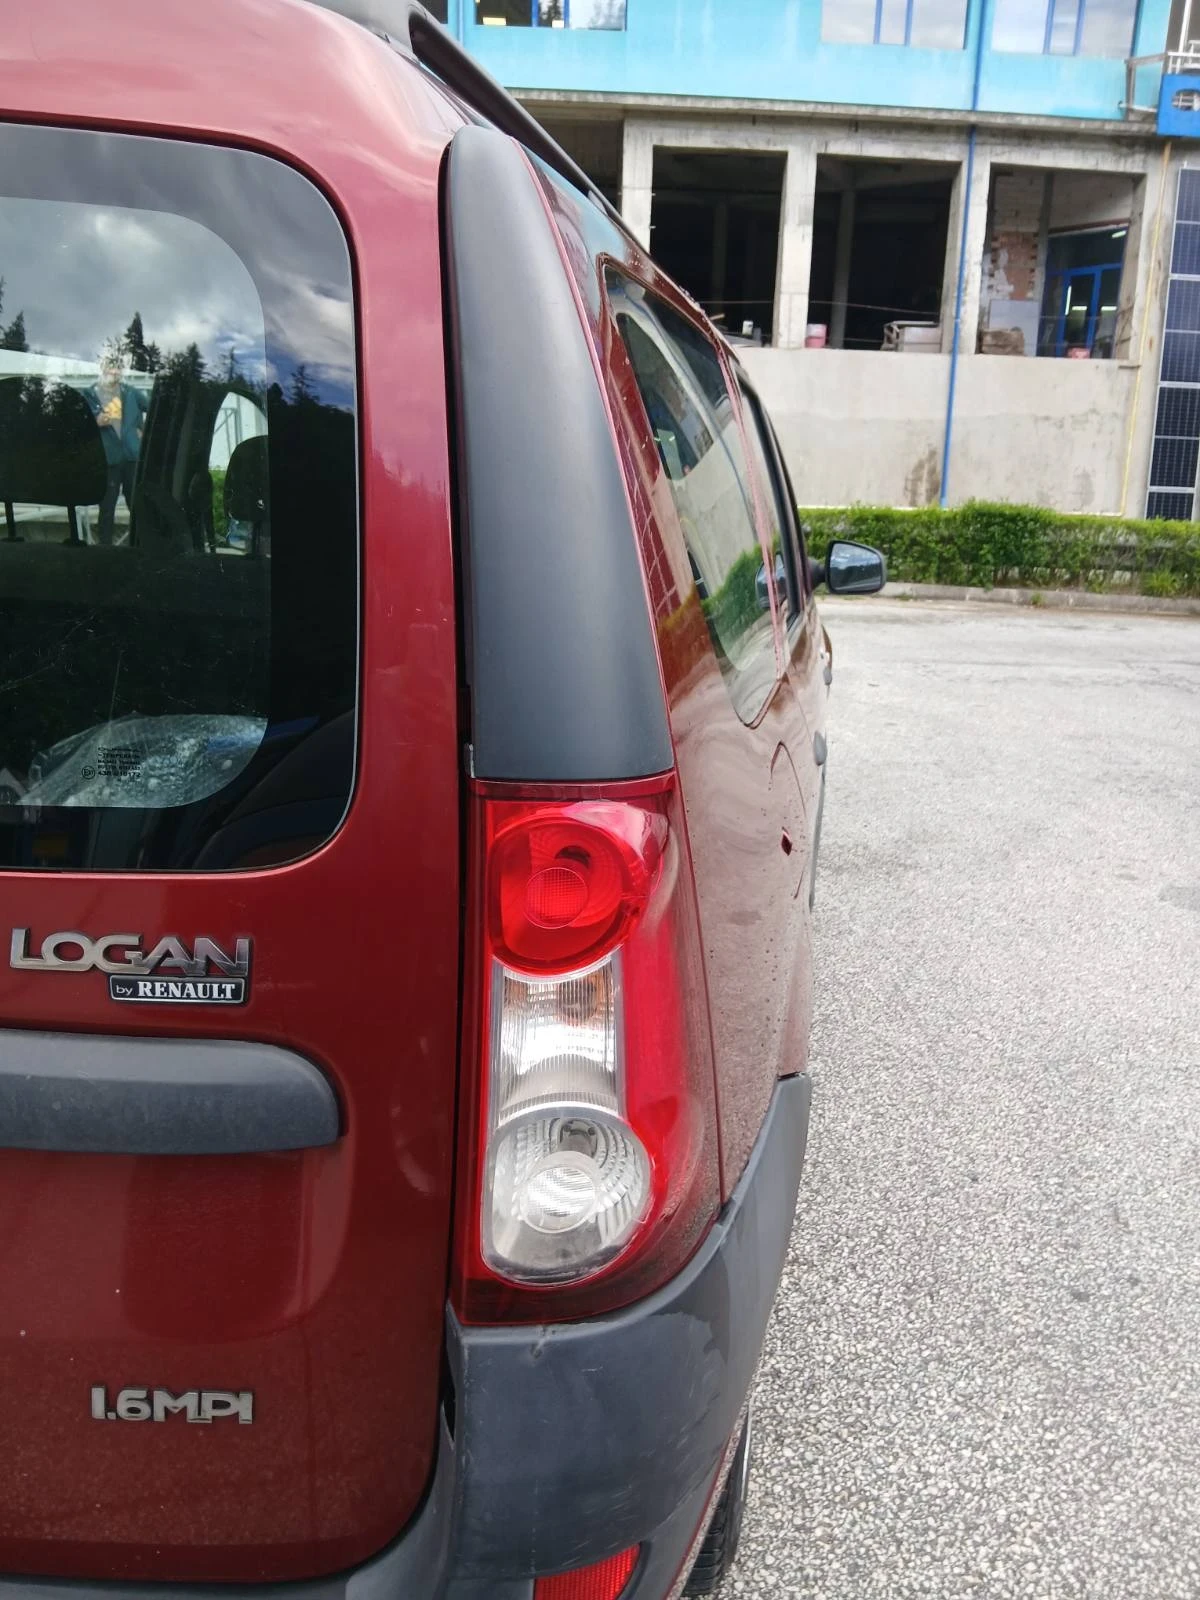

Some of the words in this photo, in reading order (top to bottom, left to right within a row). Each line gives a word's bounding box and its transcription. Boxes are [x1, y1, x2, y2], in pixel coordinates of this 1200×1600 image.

[10, 927, 250, 976] LOGAN
[116, 984, 133, 995] by
[137, 980, 236, 999] RENAULT
[91, 1387, 253, 1424] 1.6MPI
